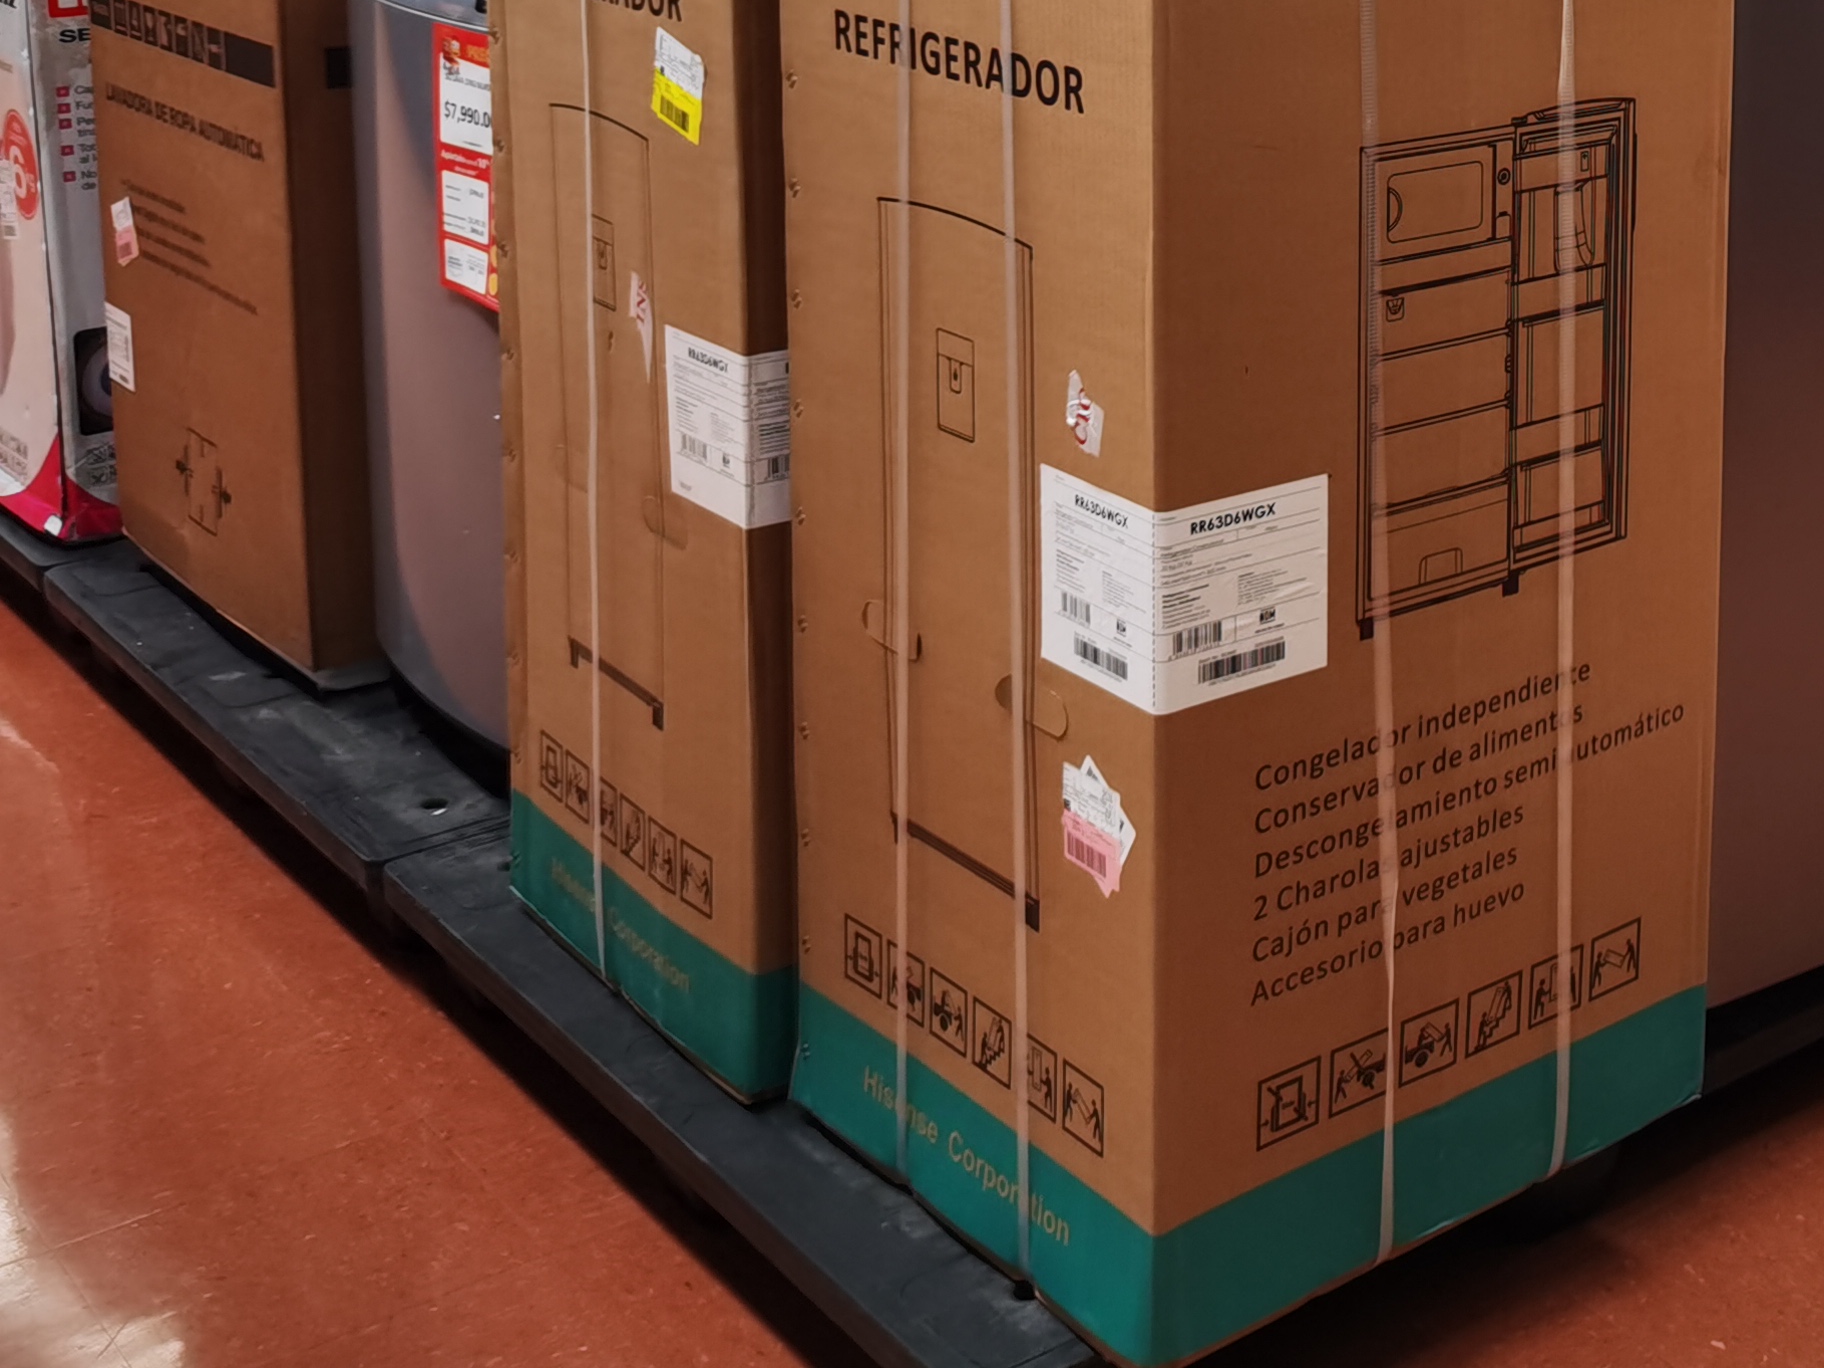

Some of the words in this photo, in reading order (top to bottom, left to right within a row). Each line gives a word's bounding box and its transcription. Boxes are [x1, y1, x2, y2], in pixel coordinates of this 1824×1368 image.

[834, 8, 1085, 114] REFRIGERADOR
[1075, 493, 1129, 529] RR63D6WGX
[1190, 502, 1277, 536] RR63D6WGX
[1254, 774, 1498, 878] Descongeamiento
[1503, 745, 1558, 790] semi
[1570, 704, 1684, 765] utomático
[1432, 746, 1463, 775] de
[1469, 701, 1584, 763] aliments
[1252, 917, 1329, 963] Cajón
[1402, 846, 1518, 908] vegetales
[1253, 895, 1268, 922] 2
[1276, 856, 1395, 912] Charola
[1399, 804, 1525, 870] ajustables
[1250, 939, 1384, 1008] Accesorio
[1393, 915, 1447, 952] para
[1454, 882, 1525, 928] huevo
[948, 1129, 1070, 1247] Corportion
